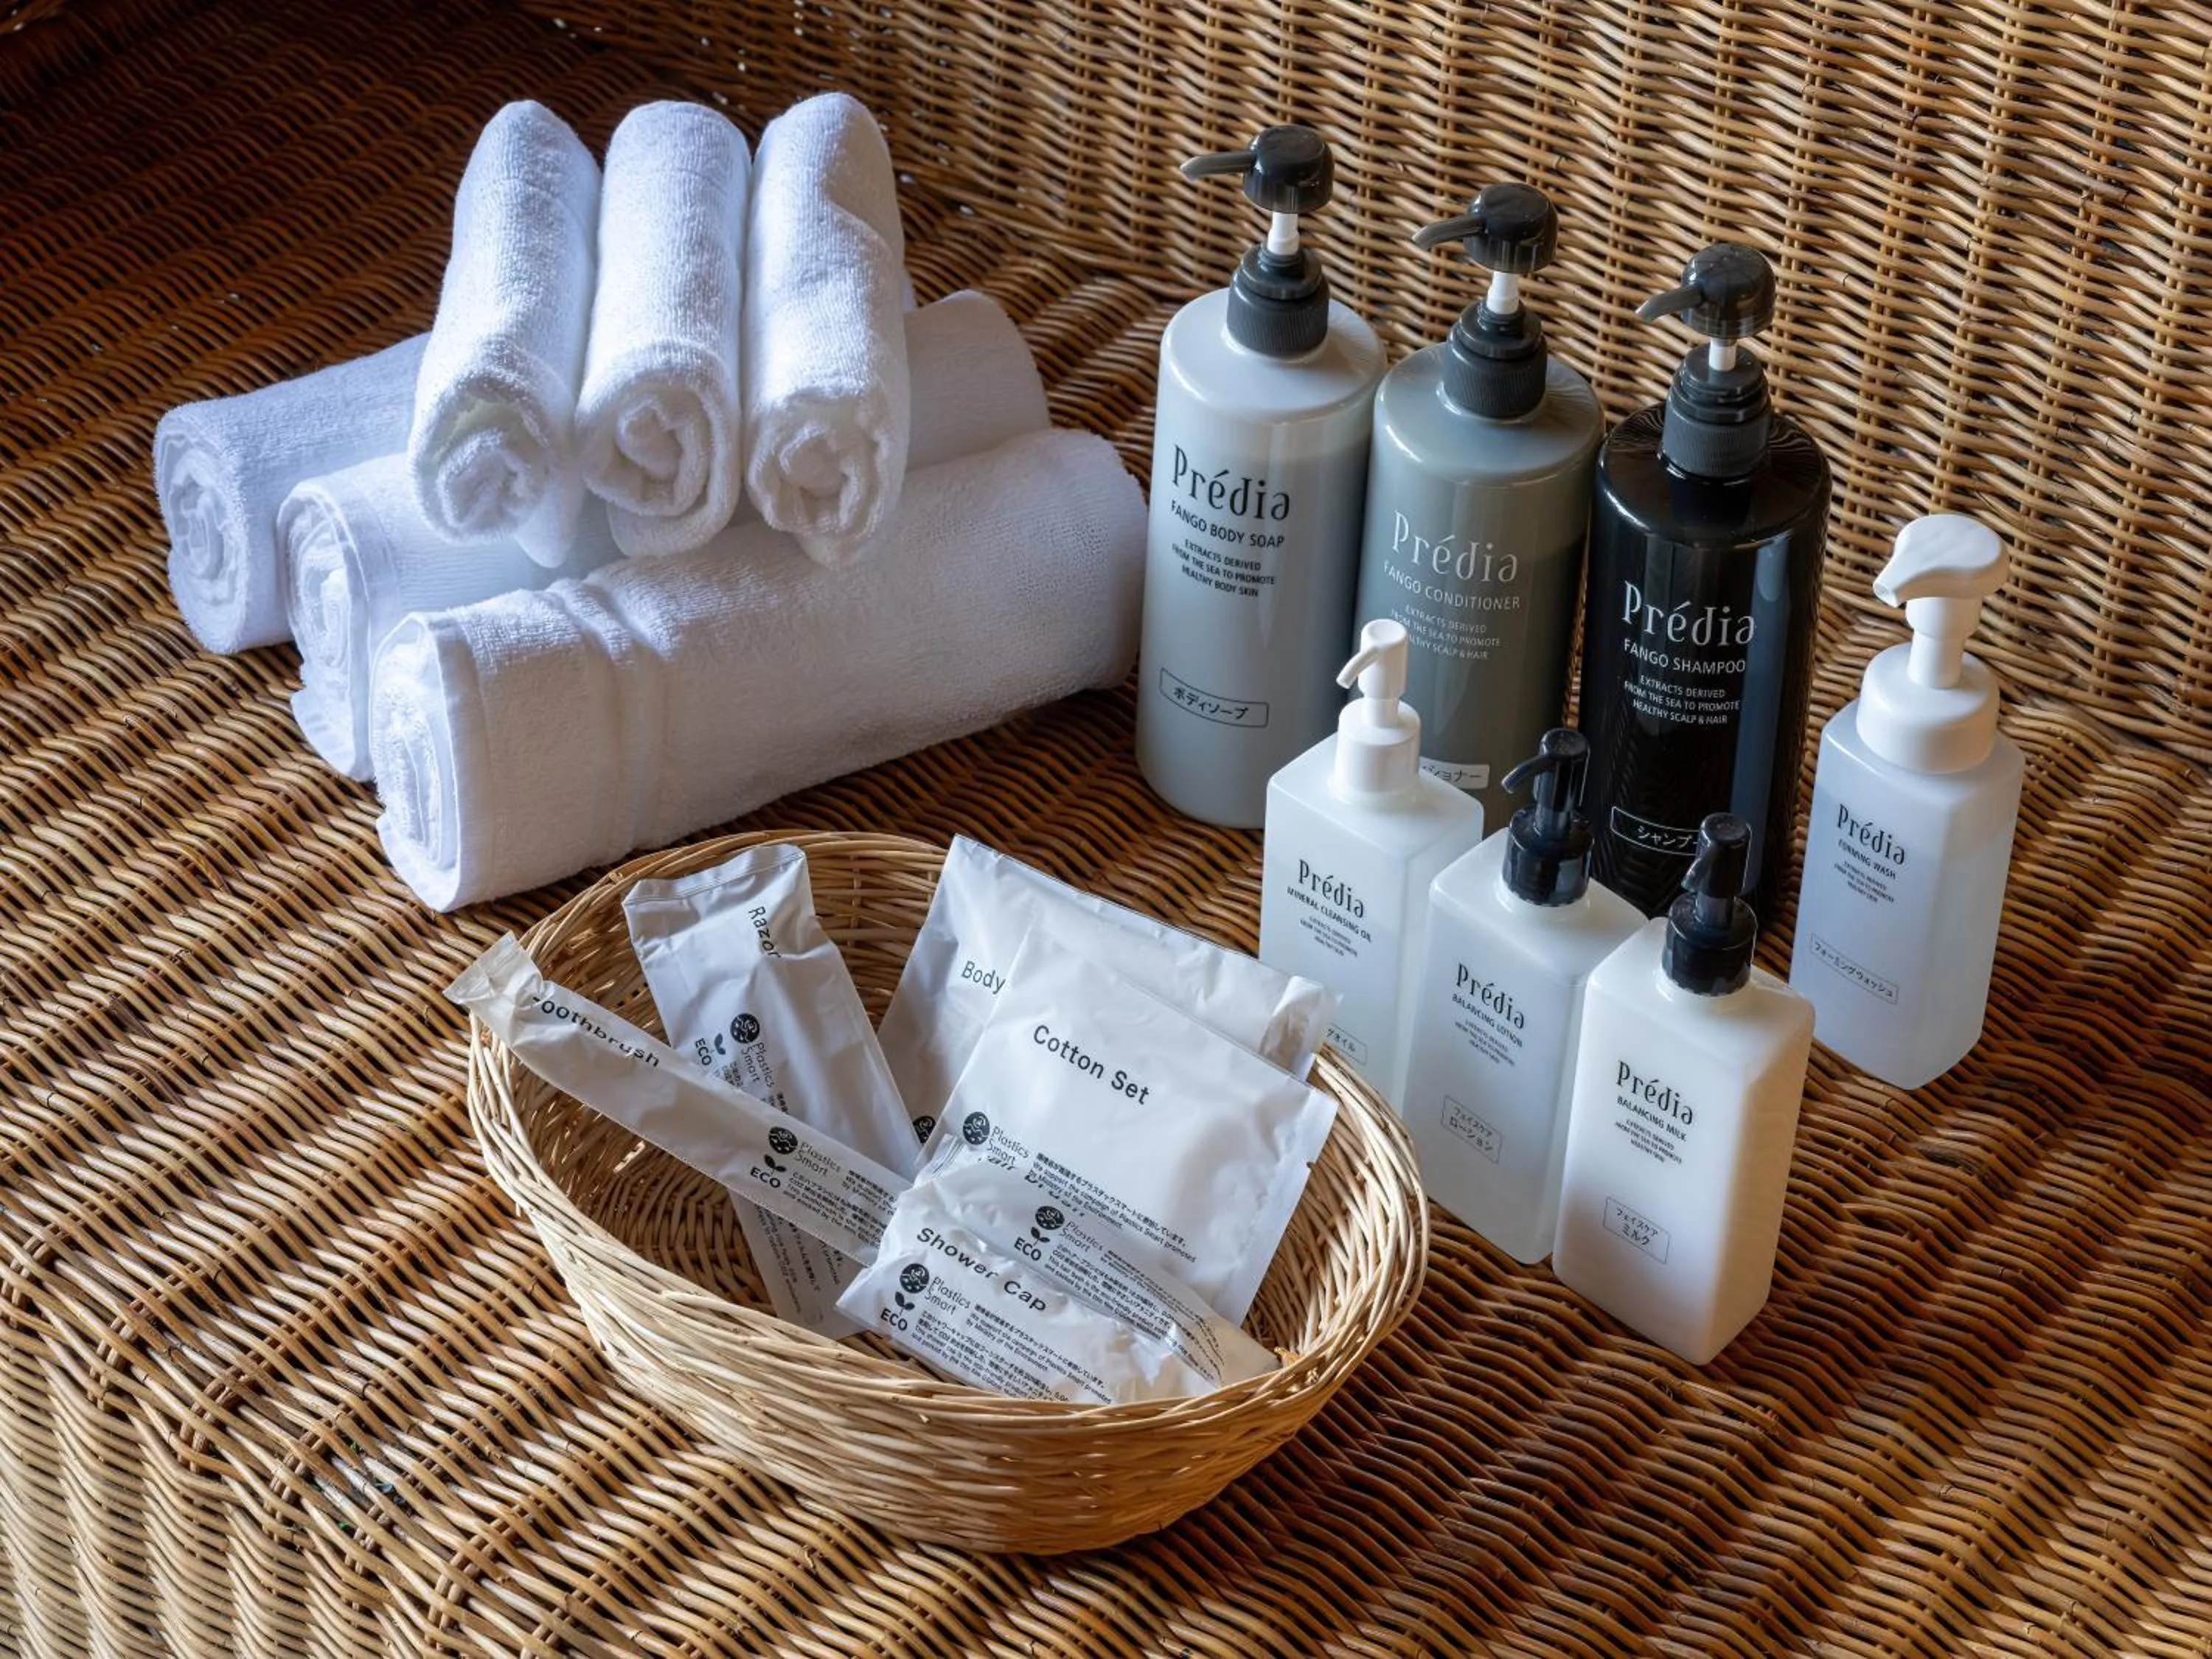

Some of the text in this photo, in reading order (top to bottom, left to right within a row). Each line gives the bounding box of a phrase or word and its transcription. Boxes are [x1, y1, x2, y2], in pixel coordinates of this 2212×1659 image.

[1172, 445, 1290, 520] Prédia
[1172, 500, 1284, 548] FANGO BODY SOAP
[1185, 539, 1261, 571] EXTRACTS DERIVED
[1392, 509, 1518, 582] Prédia
[1172, 543, 1275, 584] FROM THE SEA TO PROMOTE
[1182, 564, 1259, 597] HEALTHY BODY SKIN
[1384, 560, 1520, 610] FANGO CONDITIONER
[1622, 580, 1755, 646] Prédia
[1413, 622, 1427, 634] THE
[1447, 633, 1458, 644] TO
[1624, 638, 1745, 674] FANGO SHAMPOO
[1173, 686, 1248, 720] ボディソープ
[1624, 681, 1740, 712] FROM THE SEA TO PROMOTE
[1641, 675, 1725, 698] EXTRACTS DERIVED
[1633, 700, 1668, 718] HEALTHY
[1670, 712, 1696, 723] SCALP
[1706, 715, 1728, 724] HAIR
[1837, 804, 1905, 865] Prédia
[1873, 862, 1896, 880] WASH
[1299, 859, 1363, 918] Prédia
[749, 906, 781, 959] Razor
[961, 961, 1006, 995] Body
[1456, 962, 1524, 1029] Prédia
[695, 1037, 712, 1065] ECO
[742, 1047, 759, 1082] Smart
[752, 1042, 774, 1088] Plastics
[1033, 1025, 1150, 1105] Cotton Set
[1616, 1060, 1693, 1124] Prédia
[1617, 1096, 1686, 1141] BALANCING MILK
[801, 1141, 841, 1172] Plastics
[987, 1138, 1015, 1165] Smart
[992, 1126, 1029, 1158] Plastics
[750, 1166, 781, 1188] ECO
[793, 1151, 828, 1178] Smart
[1015, 1237, 1041, 1261] ECO
[1059, 1228, 1091, 1252] Smart
[1066, 1221, 1104, 1251] Plastics
[1623, 1224, 1649, 1245] ミルク
[917, 1228, 1046, 1311] Shower Cap
[925, 1284, 957, 1315] Smart
[933, 1276, 970, 1309] Plastics
[880, 1307, 907, 1331] ECO
